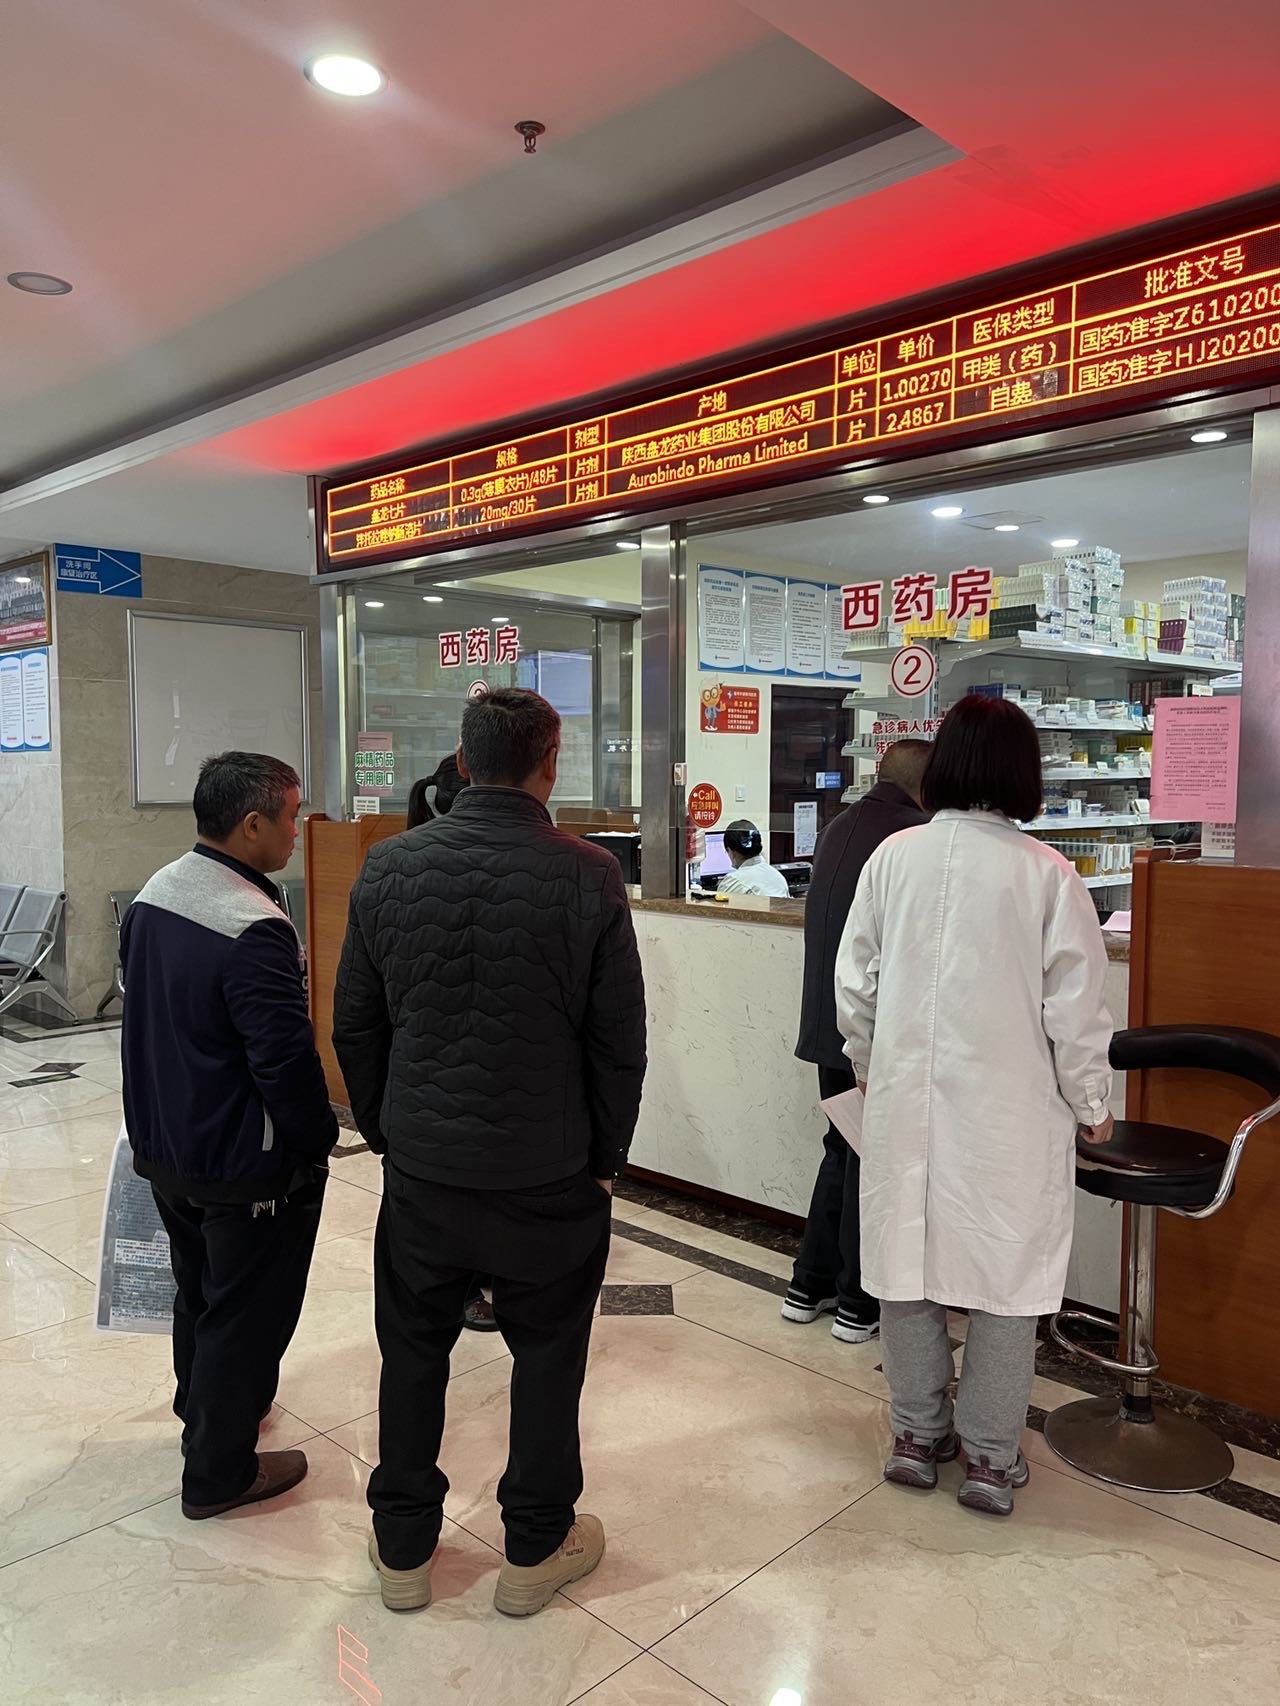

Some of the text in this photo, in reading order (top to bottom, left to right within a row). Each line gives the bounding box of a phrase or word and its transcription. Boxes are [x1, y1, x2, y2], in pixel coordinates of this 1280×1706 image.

[1144, 245, 1245, 298] 批准文号
[973, 297, 1055, 344] 医保类型
[1079, 283, 1280, 356] 国药准字Z610200
[897, 332, 935, 363] 单价
[1078, 323, 1280, 391] 国药准字HJ20200
[842, 349, 876, 377] 单位
[883, 368, 951, 402] 1.00270
[990, 380, 1033, 411] 自费
[697, 390, 727, 417] 产地
[848, 387, 867, 411] 片
[847, 418, 867, 442] 片
[886, 402, 944, 433] 2.4867
[575, 425, 599, 449] 剂型
[622, 399, 815, 466] 陕西盘龙药业集团股份有限公司
[496, 447, 518, 469] 规格
[575, 455, 599, 477] 片剂
[627, 431, 808, 490] Aurobindo Pharma Limited
[370, 477, 405, 500] 药品名称
[575, 480, 599, 502] 片剂
[371, 502, 406, 524] 盘龙七片
[480, 495, 537, 521] 20mg/30片
[842, 568, 992, 631] 西药房
[439, 625, 520, 668] 西药房
[355, 751, 394, 768] 麻精药品
[355, 770, 394, 787] 专用窗口
[698, 790, 715, 800] Call
